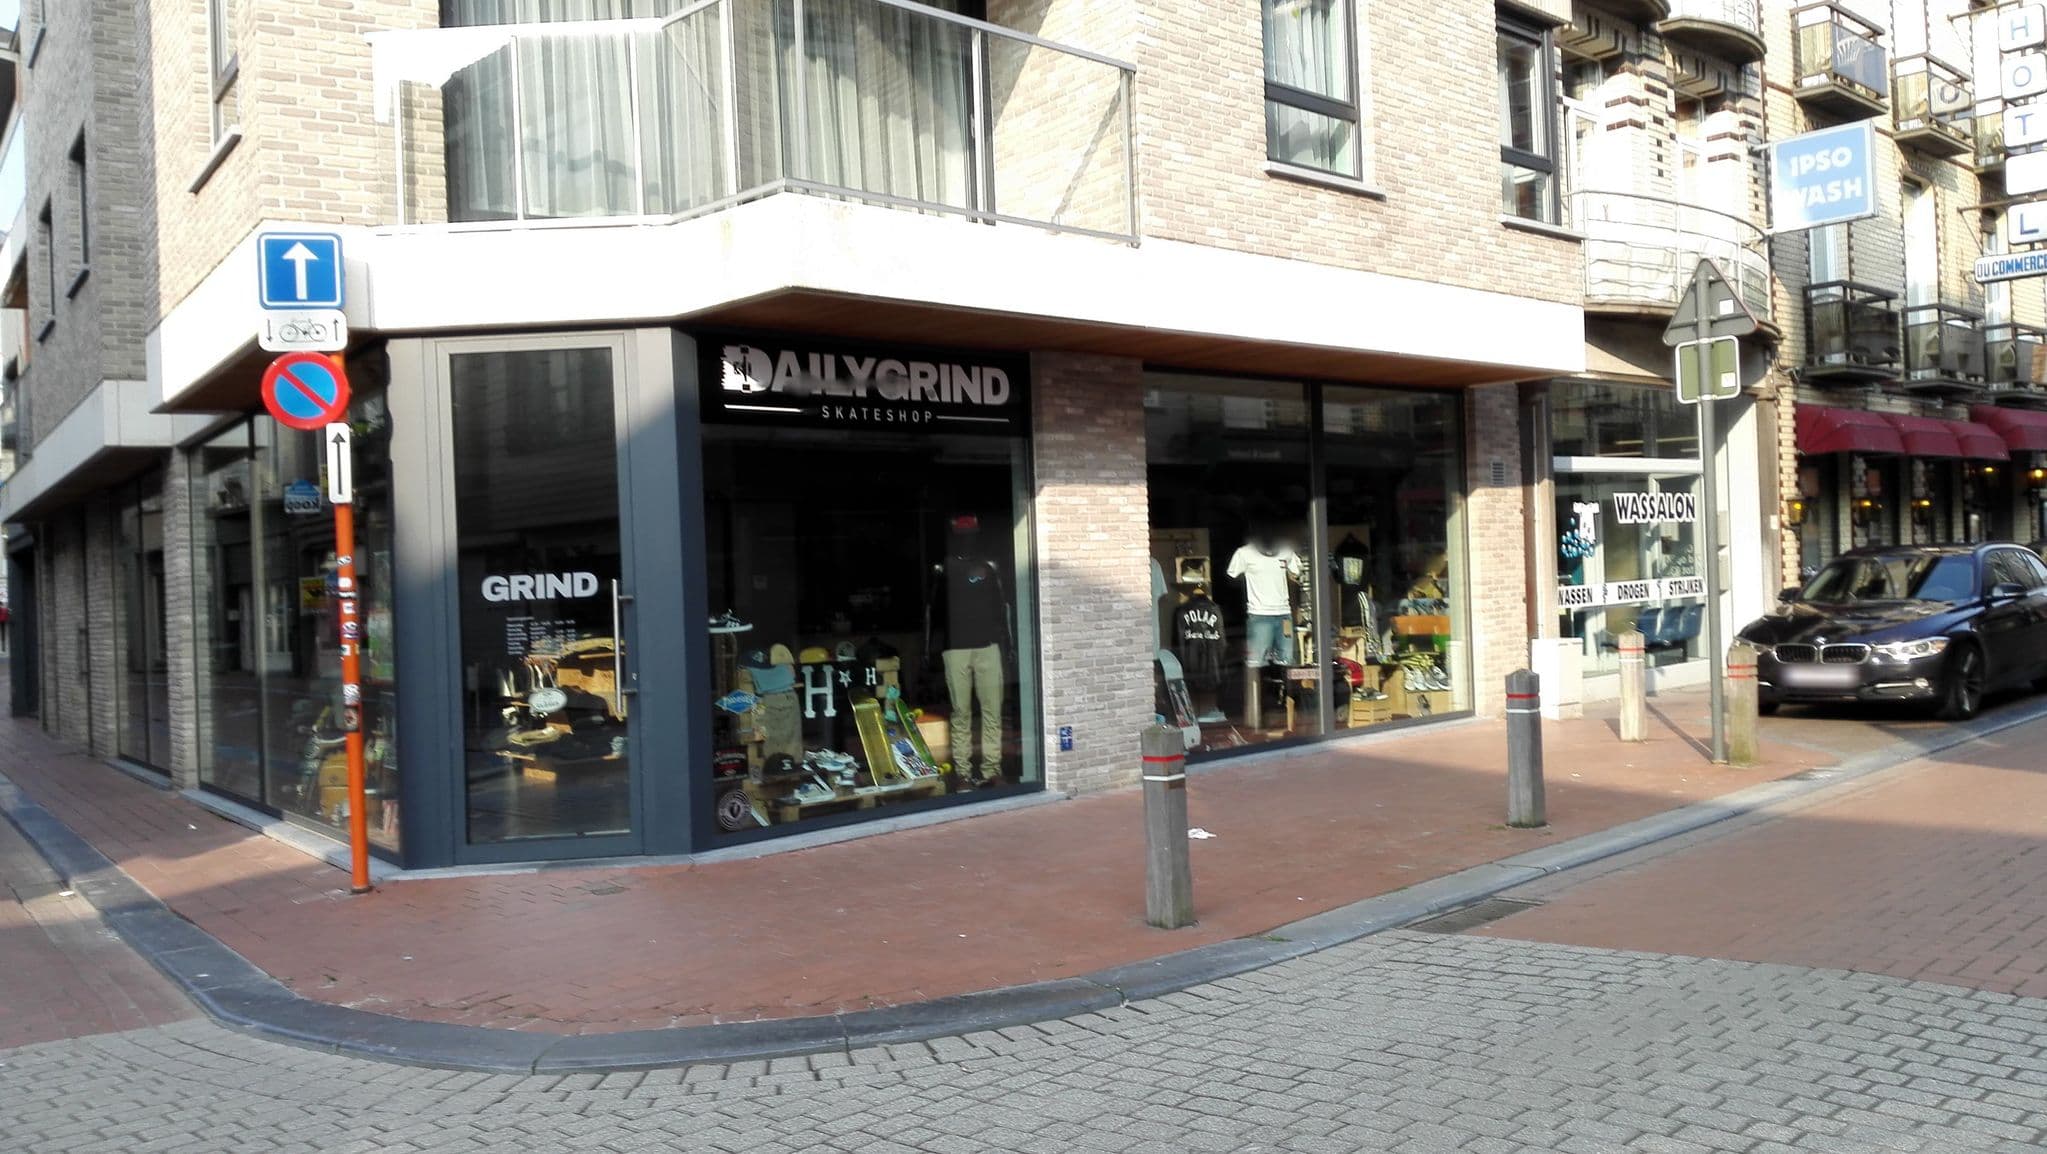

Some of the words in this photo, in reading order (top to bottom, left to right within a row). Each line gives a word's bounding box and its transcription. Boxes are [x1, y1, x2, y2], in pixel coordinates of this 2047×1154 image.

[1790, 147, 1852, 177] IPSO
[721, 345, 1011, 406] DAILYGRIND
[821, 405, 933, 424] SKATESHOP
[1616, 493, 1696, 521] WASSALON
[481, 572, 599, 602] GRIND
[1619, 584, 1649, 600] DROGEN
[1669, 580, 1703, 596] STRIJKEN
